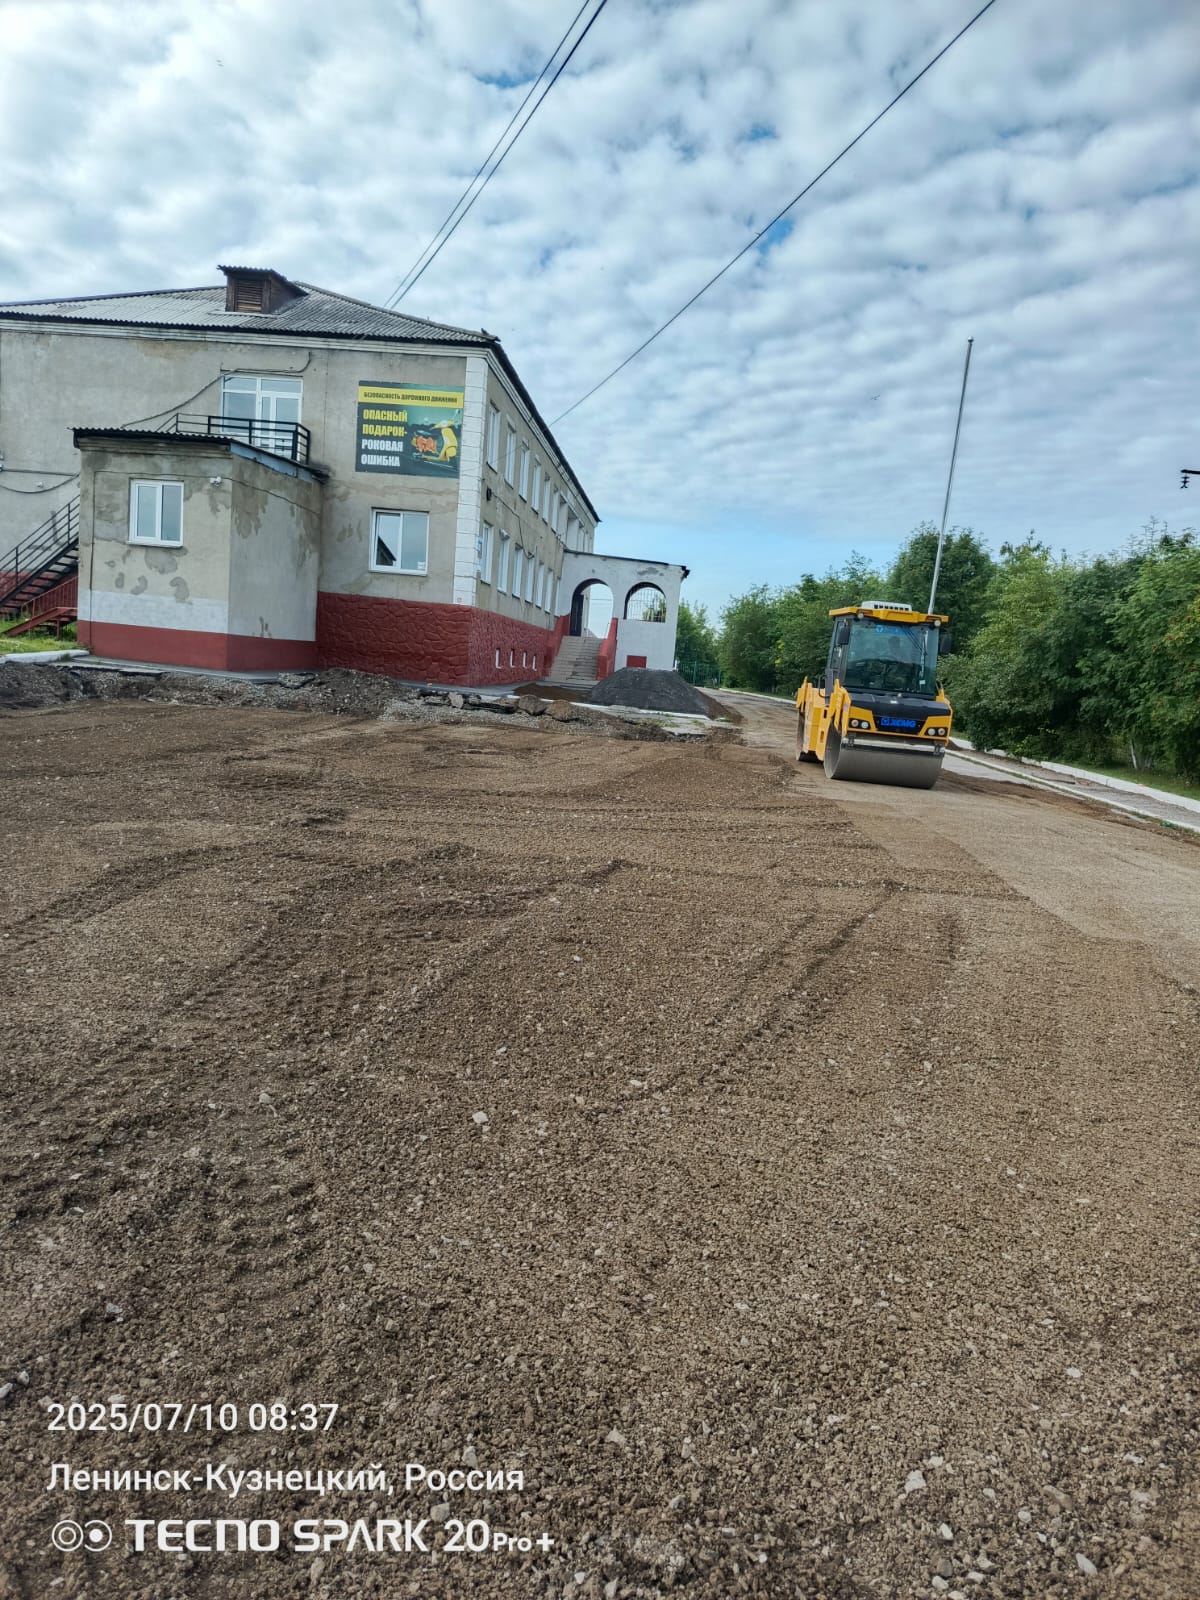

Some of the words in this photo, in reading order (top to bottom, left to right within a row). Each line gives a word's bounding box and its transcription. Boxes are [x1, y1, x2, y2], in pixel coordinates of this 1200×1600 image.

[363, 409, 408, 422] ОПАСНЫЙ
[361, 439, 404, 452] РОКОВАЯ
[361, 454, 401, 467] ОШИБКА
